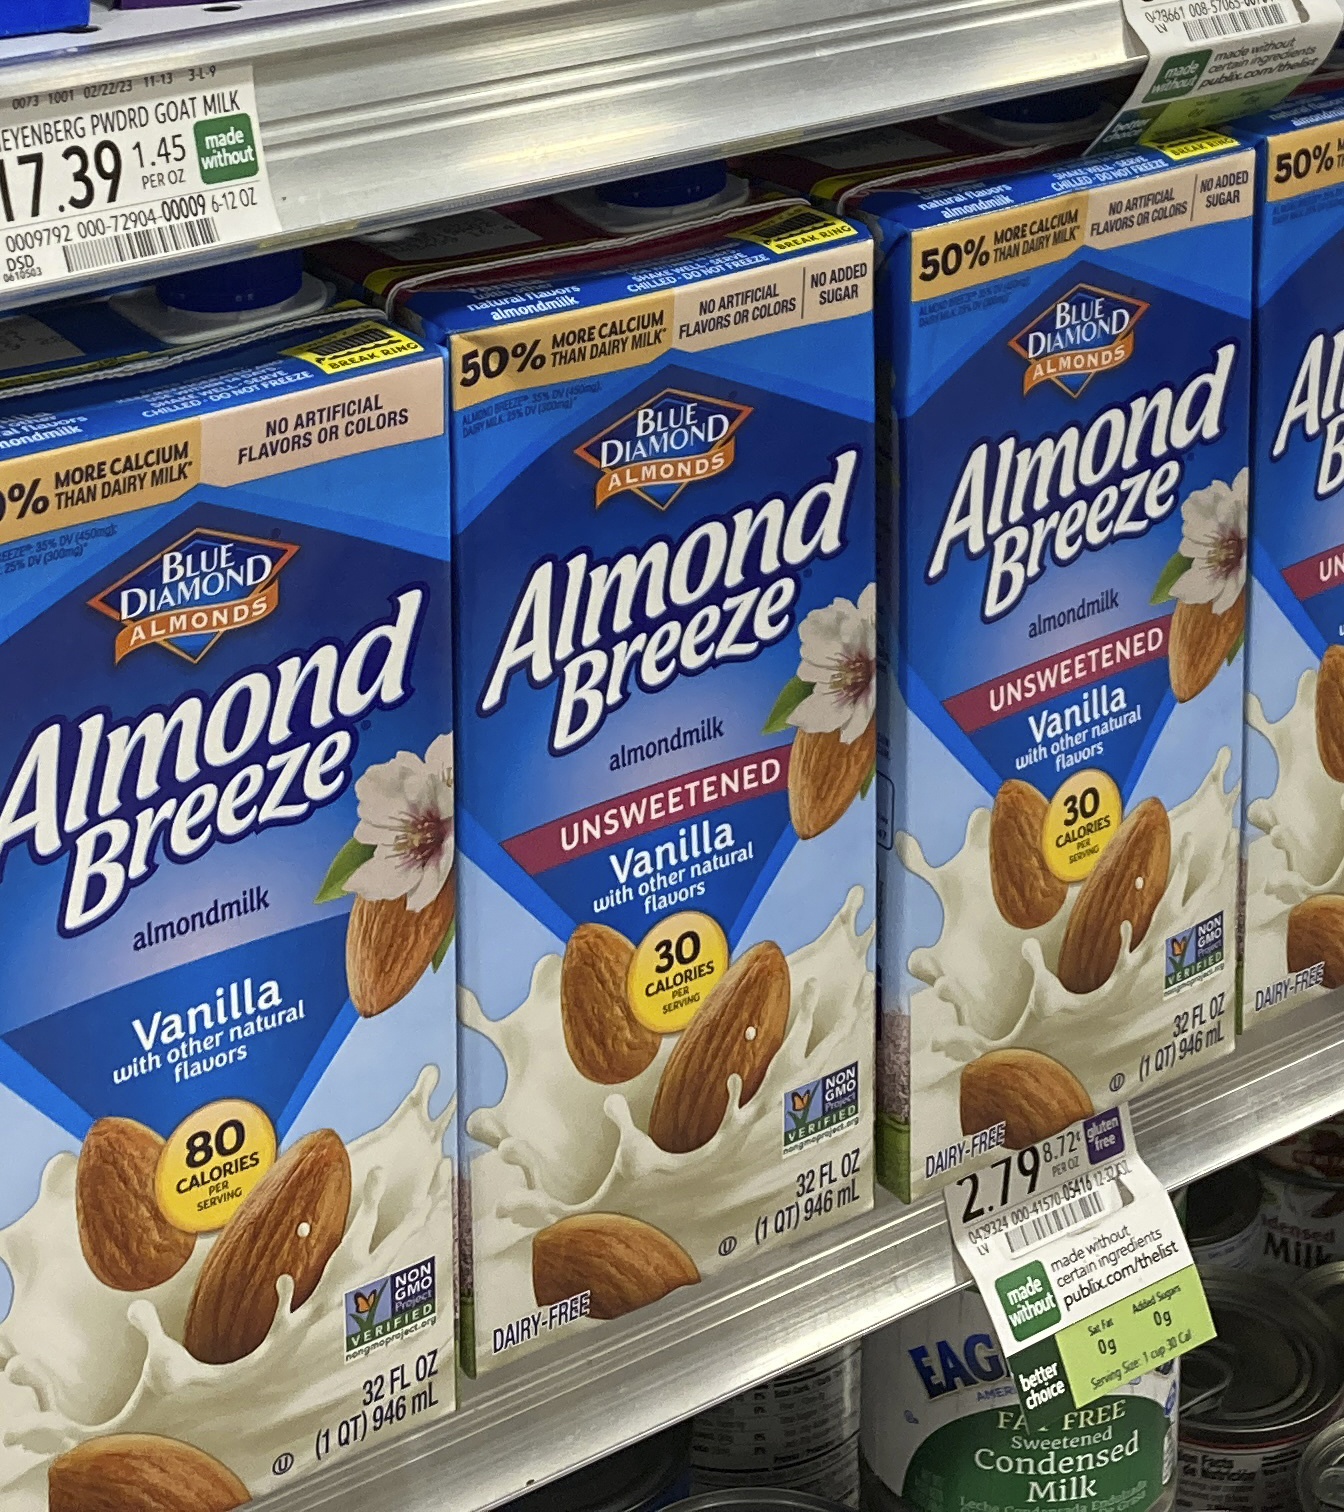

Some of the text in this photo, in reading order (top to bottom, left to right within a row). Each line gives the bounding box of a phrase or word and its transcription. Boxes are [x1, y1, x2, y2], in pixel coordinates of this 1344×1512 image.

[91, 106, 149, 135] PWDRD
[155, 97, 197, 124] GOAT
[203, 90, 241, 115] MILK
[132, 134, 186, 169] 1.45
[237, 408, 409, 466] FLAVORS OR COLORS
[265, 394, 384, 436] NO ARTIFICIAL
[927, 343, 1236, 580] Almond
[162, 544, 236, 584] BLUE
[983, 459, 1181, 620] Breeze
[120, 554, 273, 621] DIAMOND
[482, 450, 858, 712] Almond
[129, 597, 268, 647] ALMONDS
[553, 577, 795, 751] Breeze
[988, 627, 1164, 713] UNSWEETENED
[559, 756, 782, 852] UNSWEETENED
[63, 729, 352, 932] Breeze
[132, 886, 270, 952] almondmilk
[654, 930, 700, 974] 30
[131, 977, 283, 1052] Vanilla
[184, 1118, 246, 1170] 80
[1087, 1115, 1119, 1141] gluten
[1094, 1133, 1116, 1151] free
[176, 1151, 260, 1195] CALORIES
[957, 1145, 1040, 1224] 2.79
[1063, 1240, 1179, 1311] publix.com/thelist
[350, 1303, 435, 1349] VERIFIED
[492, 1290, 591, 1349] DAIRY-FREE
[1019, 1362, 1058, 1392] better
[1025, 1377, 1066, 1411] choice
[974, 1429, 1140, 1477] Condensed
[1011, 1427, 1113, 1452] Sweetened
[1026, 1474, 1096, 1503] Milk
